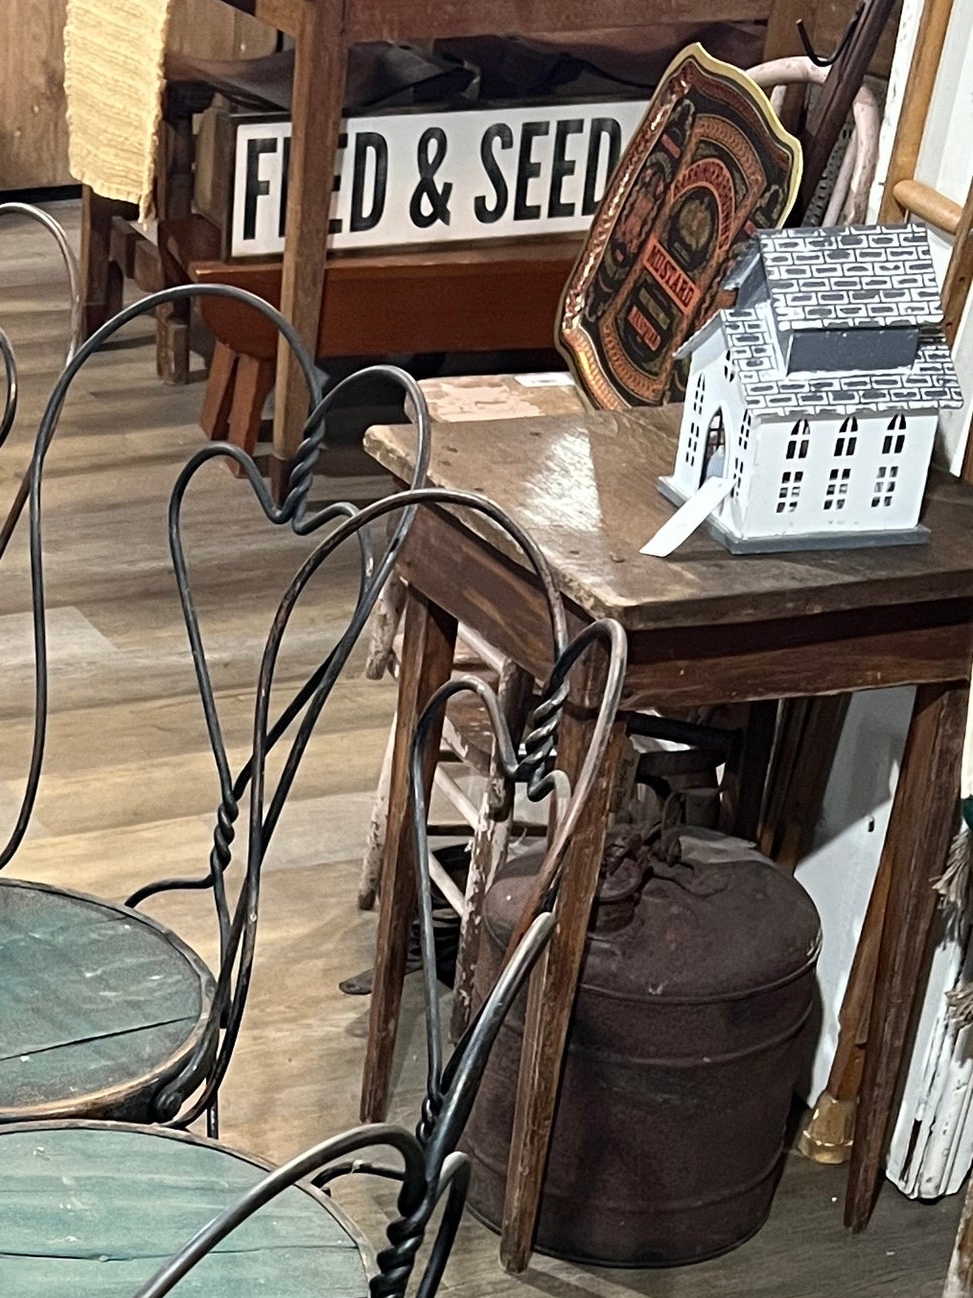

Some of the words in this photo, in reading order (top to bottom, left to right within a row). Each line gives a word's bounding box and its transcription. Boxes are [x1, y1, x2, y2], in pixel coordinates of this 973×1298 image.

[409, 126, 454, 229] &
[473, 117, 623, 225] SEED
[647, 244, 695, 308] MUSTARD
